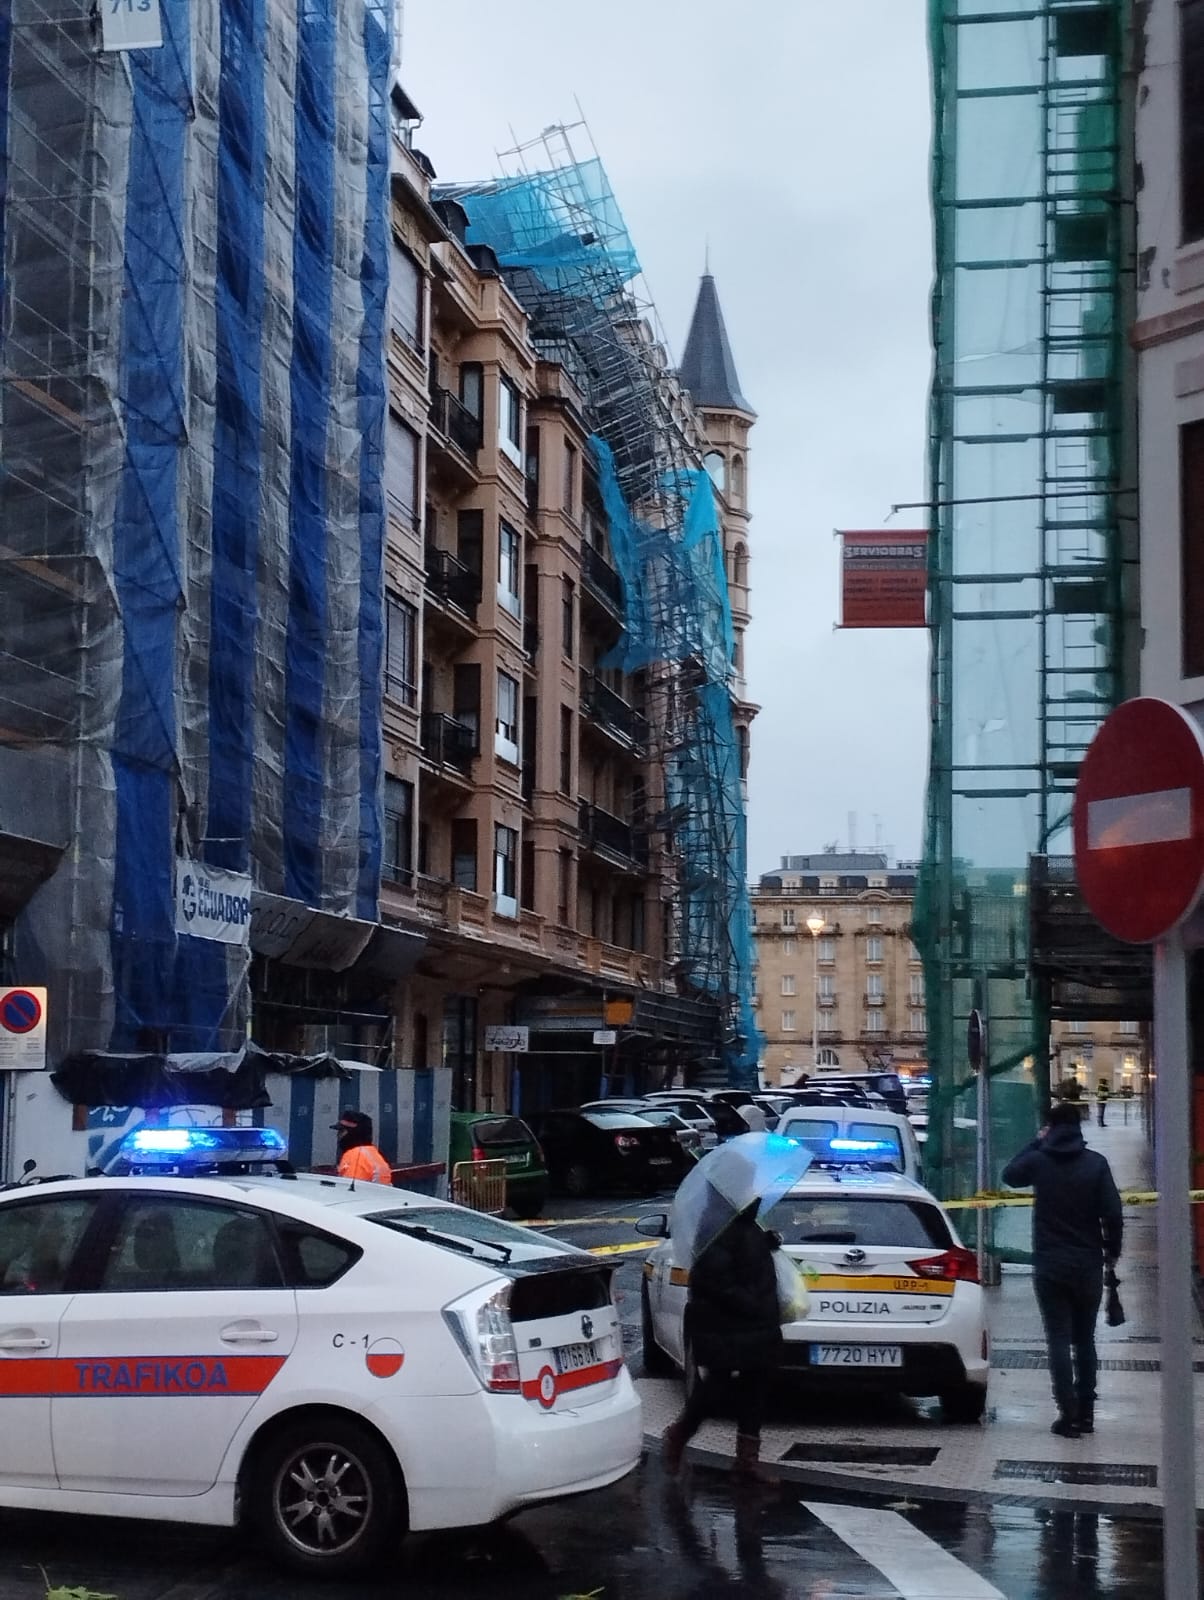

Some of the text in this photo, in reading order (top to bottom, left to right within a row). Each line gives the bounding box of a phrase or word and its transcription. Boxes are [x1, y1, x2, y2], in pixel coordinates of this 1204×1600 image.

[820, 1301, 890, 1314] POLIZIA
[821, 1347, 897, 1363] 7720 HYV
[74, 1362, 228, 1388] TRAFIKOA
